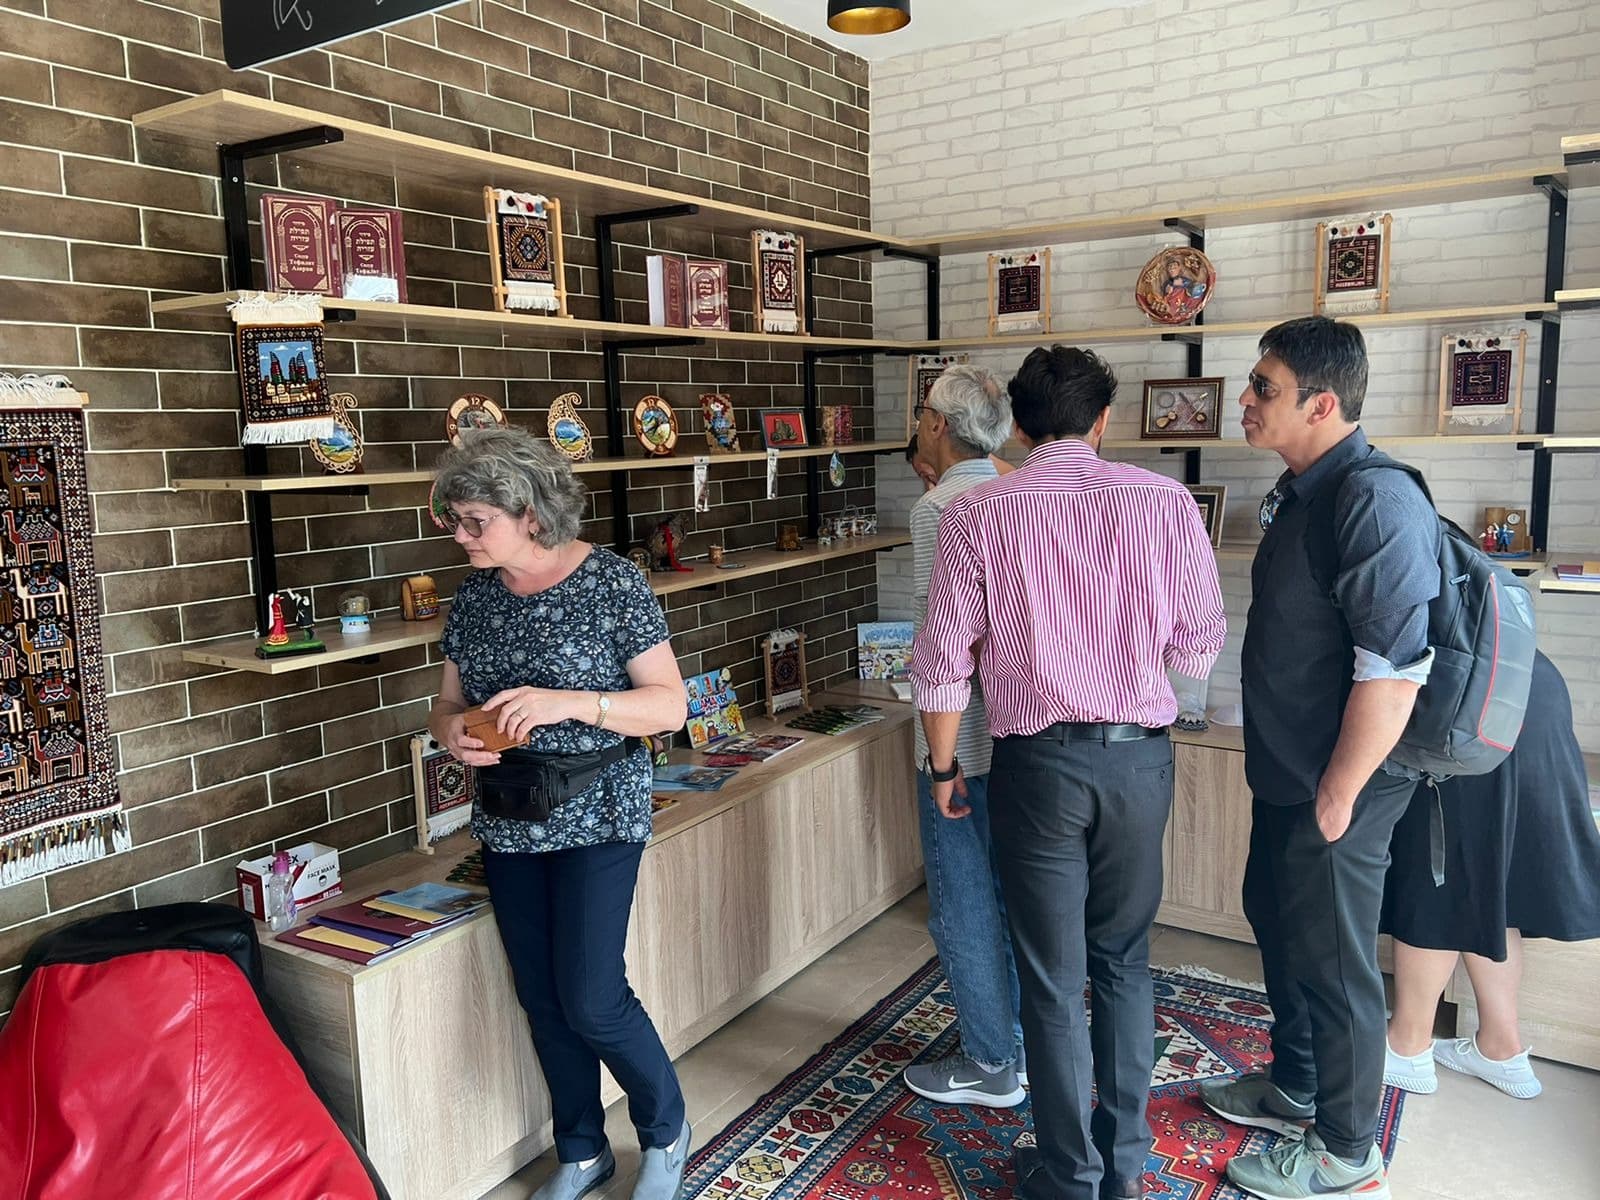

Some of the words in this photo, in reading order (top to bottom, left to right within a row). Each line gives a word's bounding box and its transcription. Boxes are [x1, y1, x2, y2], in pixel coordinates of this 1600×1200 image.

[470, 397, 481, 405] 12
[307, 869, 320, 879] FACE
[320, 864, 336, 873] MASK
